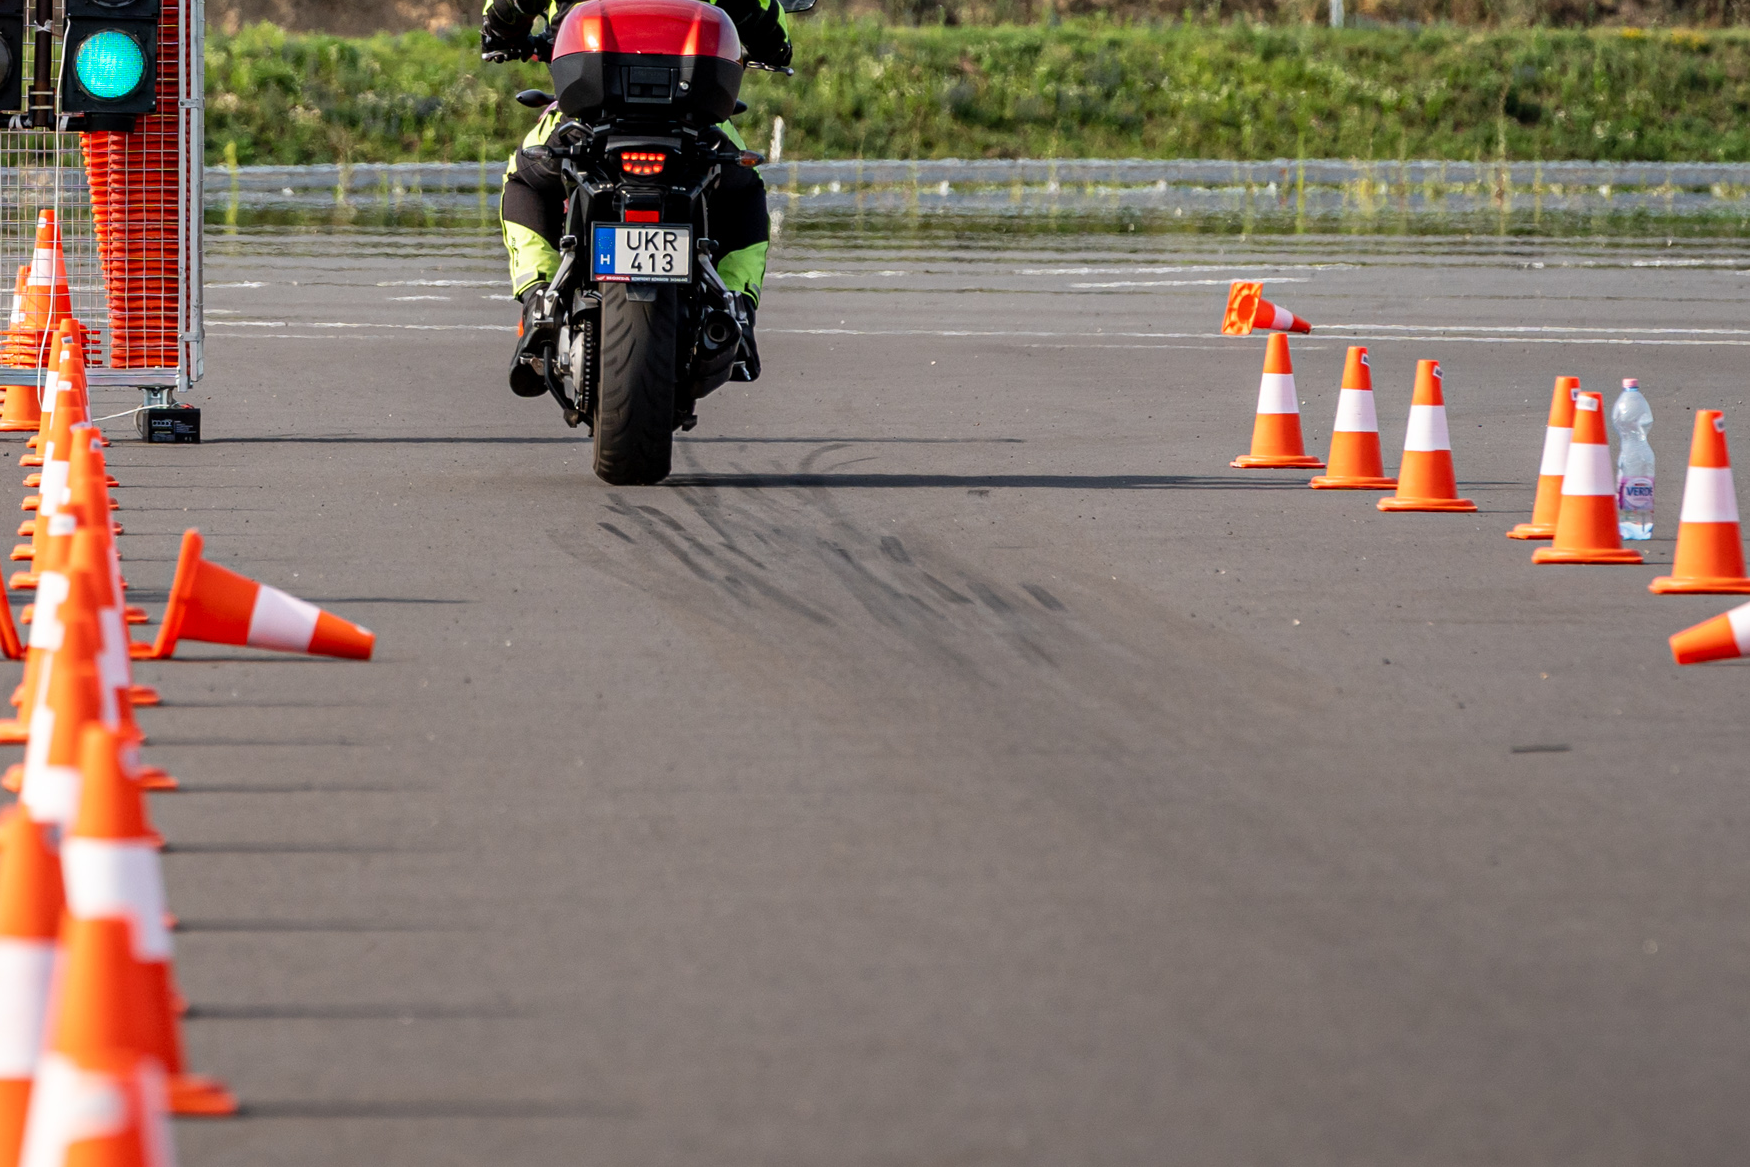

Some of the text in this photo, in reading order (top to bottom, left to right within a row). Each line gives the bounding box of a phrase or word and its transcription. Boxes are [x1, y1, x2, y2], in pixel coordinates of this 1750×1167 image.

[626, 230, 678, 251] UKR
[600, 254, 611, 265] H
[630, 253, 674, 273] 413
[1626, 486, 1654, 497] VERDE
